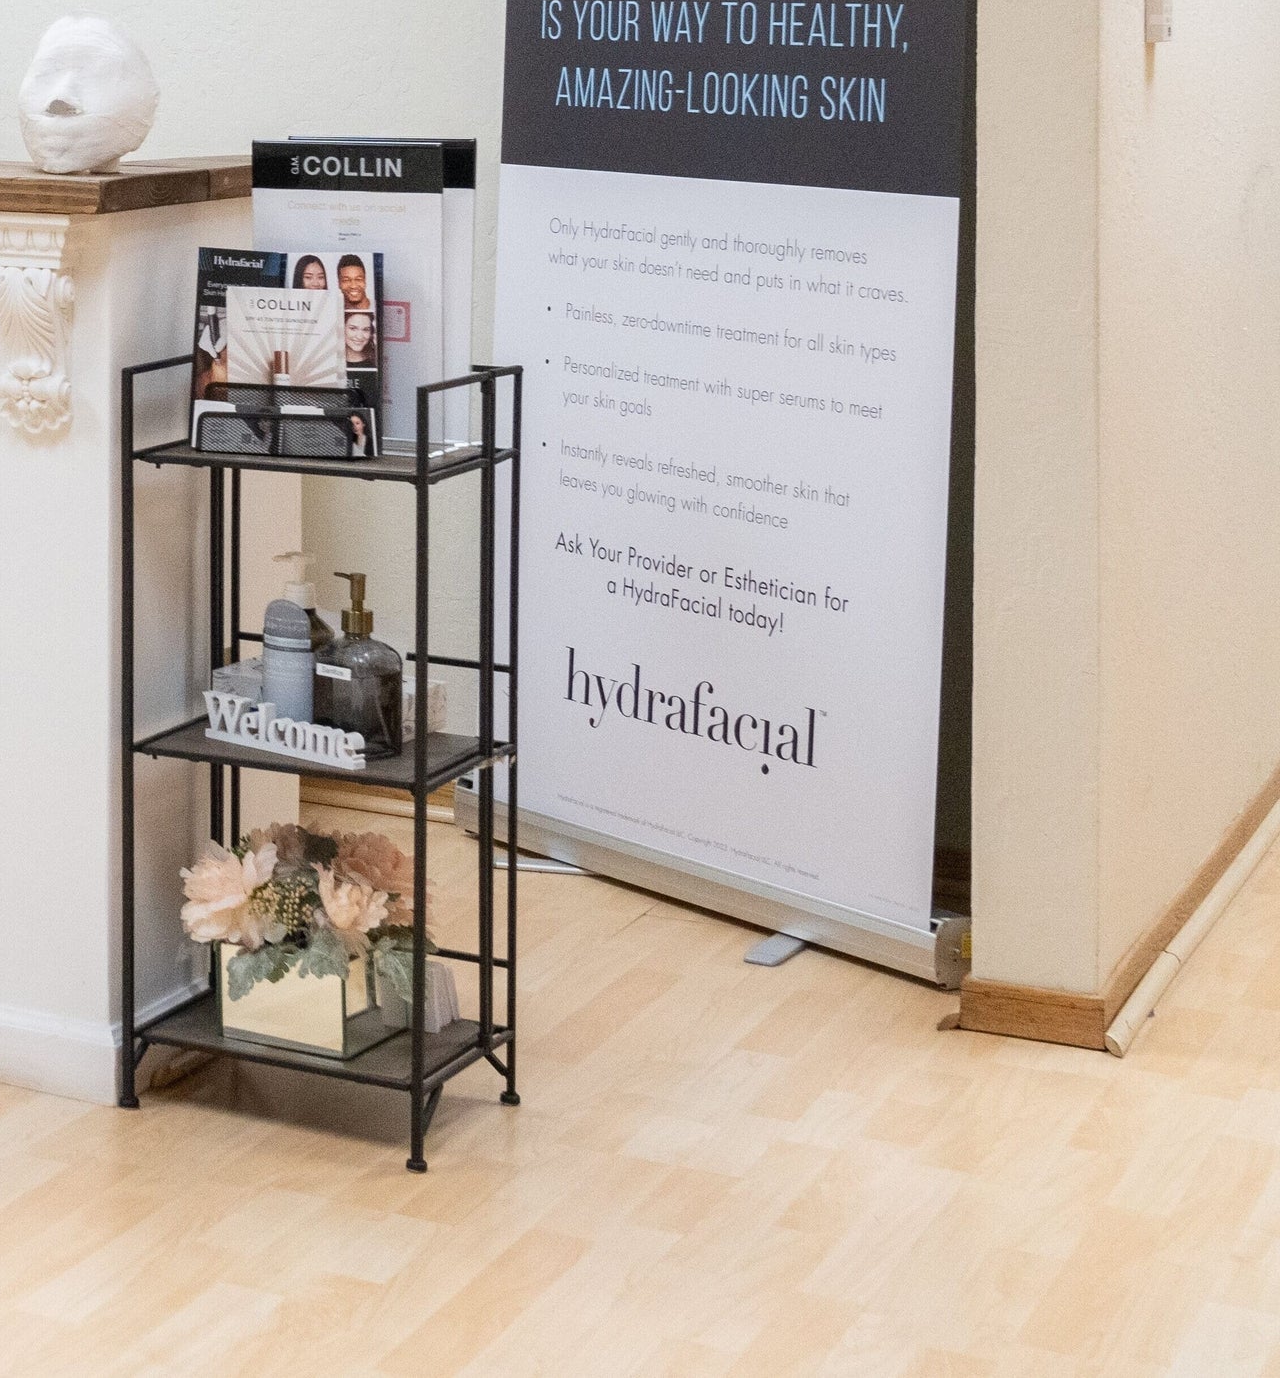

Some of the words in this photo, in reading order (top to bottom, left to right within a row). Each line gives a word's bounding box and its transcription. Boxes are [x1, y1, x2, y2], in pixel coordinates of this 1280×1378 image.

[541, 0, 562, 40] IS
[573, 0, 640, 42] YOUR
[651, 1, 710, 44] WAY
[721, 2, 758, 45] TO
[769, 2, 909, 53] HEALTHY,
[555, 66, 808, 120] AMAZING-LOOKING
[820, 76, 887, 123] SKIN
[303, 155, 402, 178] COLLIN
[550, 217, 579, 240] Only
[583, 220, 656, 243] HydraFacial
[660, 229, 697, 252] gently
[702, 232, 728, 250] and
[734, 233, 806, 263] thoroughly
[811, 246, 867, 264] removes
[256, 298, 312, 312] COLLIN
[548, 247, 578, 266] what
[582, 255, 608, 272] your
[612, 253, 635, 272] skin
[639, 256, 681, 277] doesn't
[686, 264, 718, 282] need
[724, 267, 751, 285] and
[756, 274, 784, 292] puts
[789, 275, 801, 291] in
[806, 274, 840, 295] what
[846, 281, 854, 297] it
[858, 285, 909, 303] craves.
[565, 302, 616, 326] Painless,
[622, 312, 712, 338] zero-downtime
[716, 324, 779, 346] treatment
[784, 328, 802, 349] for
[807, 333, 824, 352] all
[829, 334, 855, 356] skin
[860, 342, 897, 364] types
[562, 391, 589, 408] your
[593, 390, 616, 410] skin
[620, 398, 653, 417] goals
[563, 355, 640, 383] Personalized
[644, 370, 700, 392] treatment
[704, 378, 732, 397] with
[737, 385, 774, 406] super
[779, 392, 826, 412] serums
[831, 397, 844, 414] to
[849, 403, 882, 420] meet
[559, 468, 598, 492] leaves
[601, 482, 623, 498] you
[627, 483, 676, 513] glowing
[680, 495, 707, 514] with
[712, 501, 788, 529] confidence
[560, 439, 608, 468] Instantly
[612, 451, 653, 472] reveals
[657, 457, 720, 486] refreshed,
[726, 474, 788, 496] smoother
[793, 480, 819, 502] skin
[824, 485, 850, 507] that
[555, 531, 583, 556] Ask
[589, 537, 622, 564] Your
[627, 546, 694, 579] Provider
[699, 568, 717, 586] or
[724, 566, 817, 607] Esthetician
[824, 585, 849, 612] for
[606, 579, 617, 595] a
[622, 576, 722, 619] HydraFacial
[728, 603, 784, 637] today!
[202, 690, 366, 769] Welcome
[563, 645, 818, 775] hydrafacial
